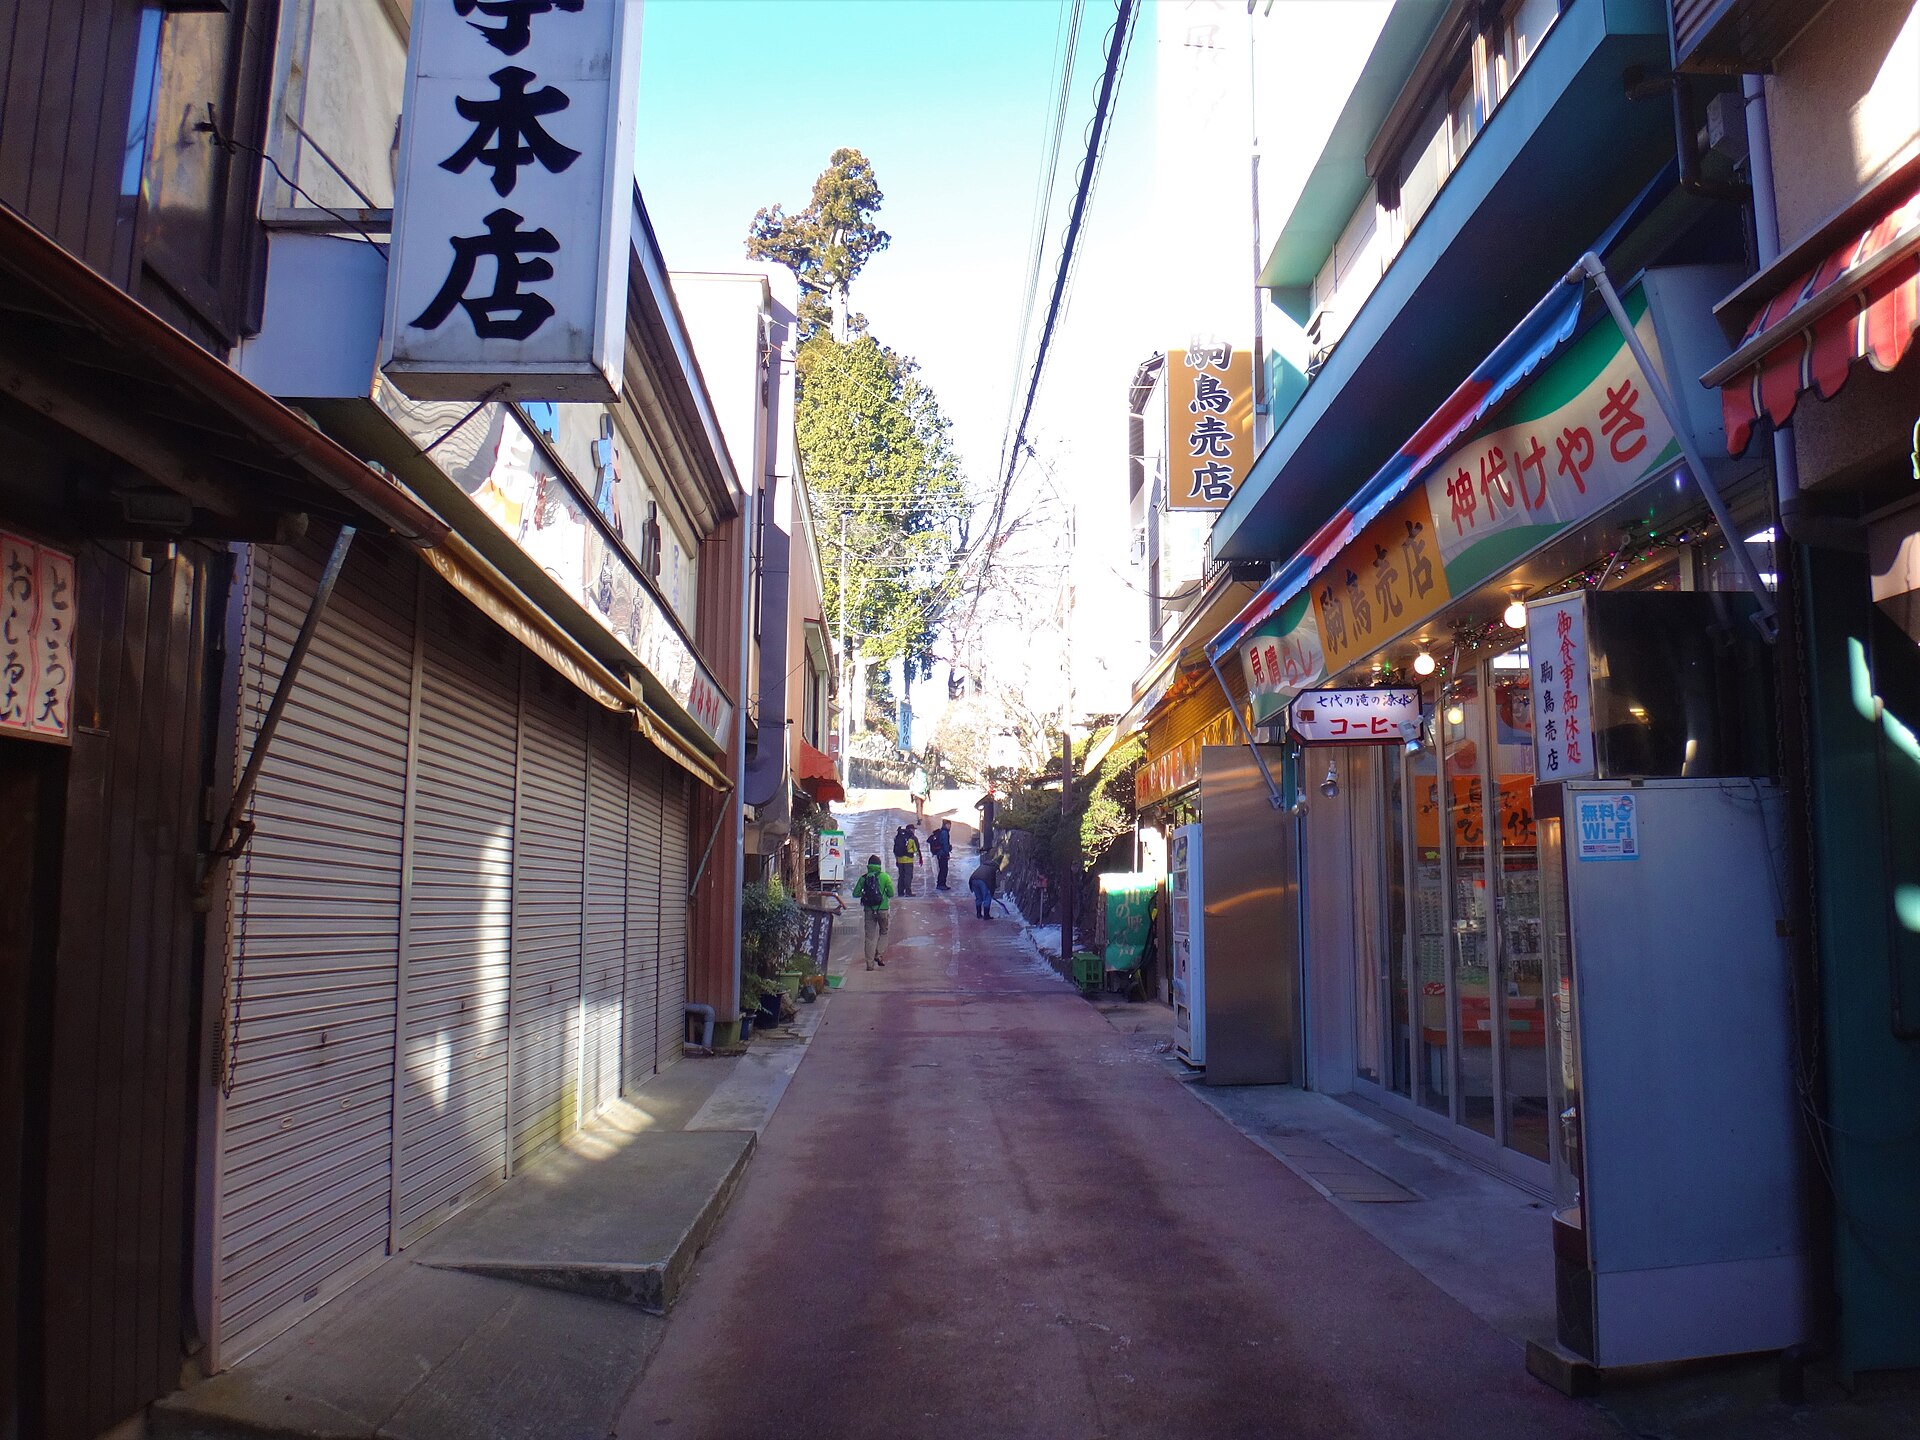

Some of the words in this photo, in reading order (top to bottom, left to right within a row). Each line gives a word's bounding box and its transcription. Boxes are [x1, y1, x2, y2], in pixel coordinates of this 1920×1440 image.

[1184, 331, 1234, 501] 駒鳥売店
[1447, 379, 1647, 536] 神代けやき
[1320, 520, 1434, 655] 駒鳥売店
[1250, 638, 1313, 687] 見晴らし
[1540, 661, 1559, 771] 駒鳥売店
[1581, 804, 1614, 821] 無料
[1583, 821, 1631, 839] Wi-Fi
